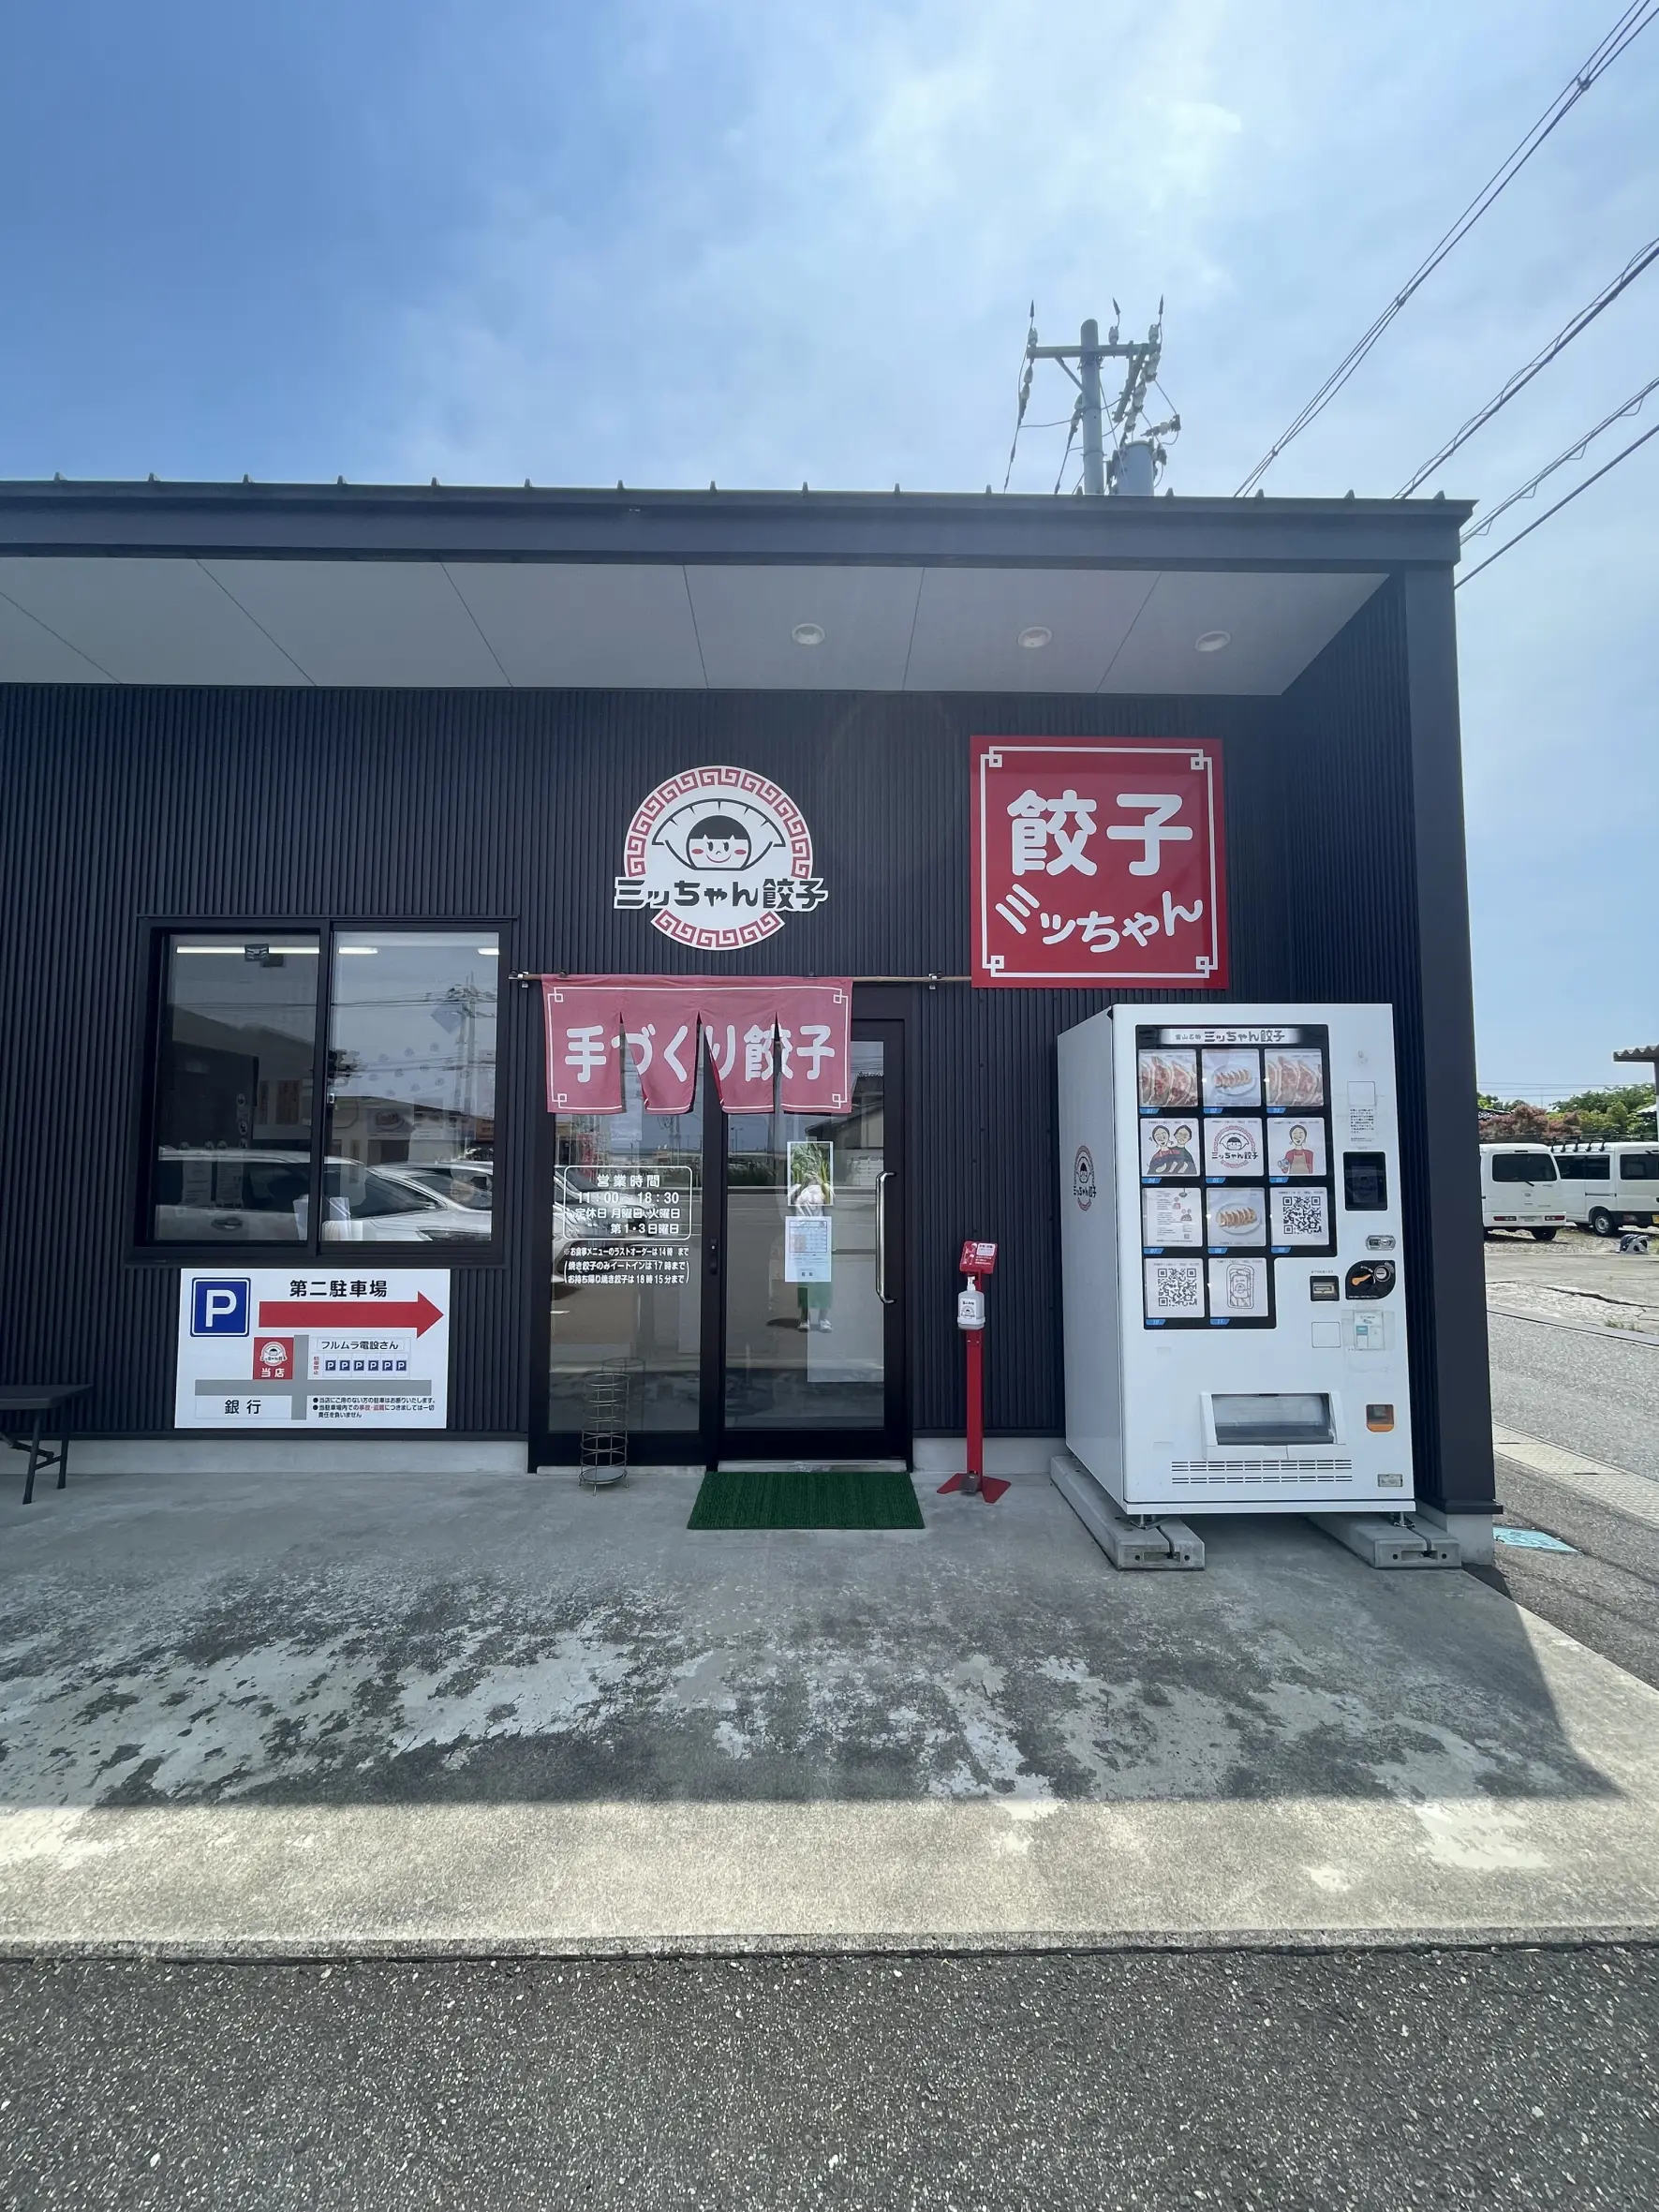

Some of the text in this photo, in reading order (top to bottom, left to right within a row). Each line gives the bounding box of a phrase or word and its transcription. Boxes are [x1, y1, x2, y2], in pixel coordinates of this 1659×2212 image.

[1006, 789, 1193, 876] 餃子
[615, 877, 827, 911] ミッちゃん餃子
[995, 883, 1203, 953] ミッちゃん
[1204, 1029, 1285, 1043] ミッちゃん餃子
[564, 1023, 836, 1082] 手づくり餃子
[597, 1174, 660, 1187] 営業時間
[574, 1208, 607, 1219] 定休日
[289, 1279, 388, 1298] 第二駐車場
[205, 1289, 237, 1327] P
[321, 1341, 399, 1350] フルムラ電設さん
[260, 1367, 286, 1378] 当店
[224, 1399, 261, 1416] 銀行
